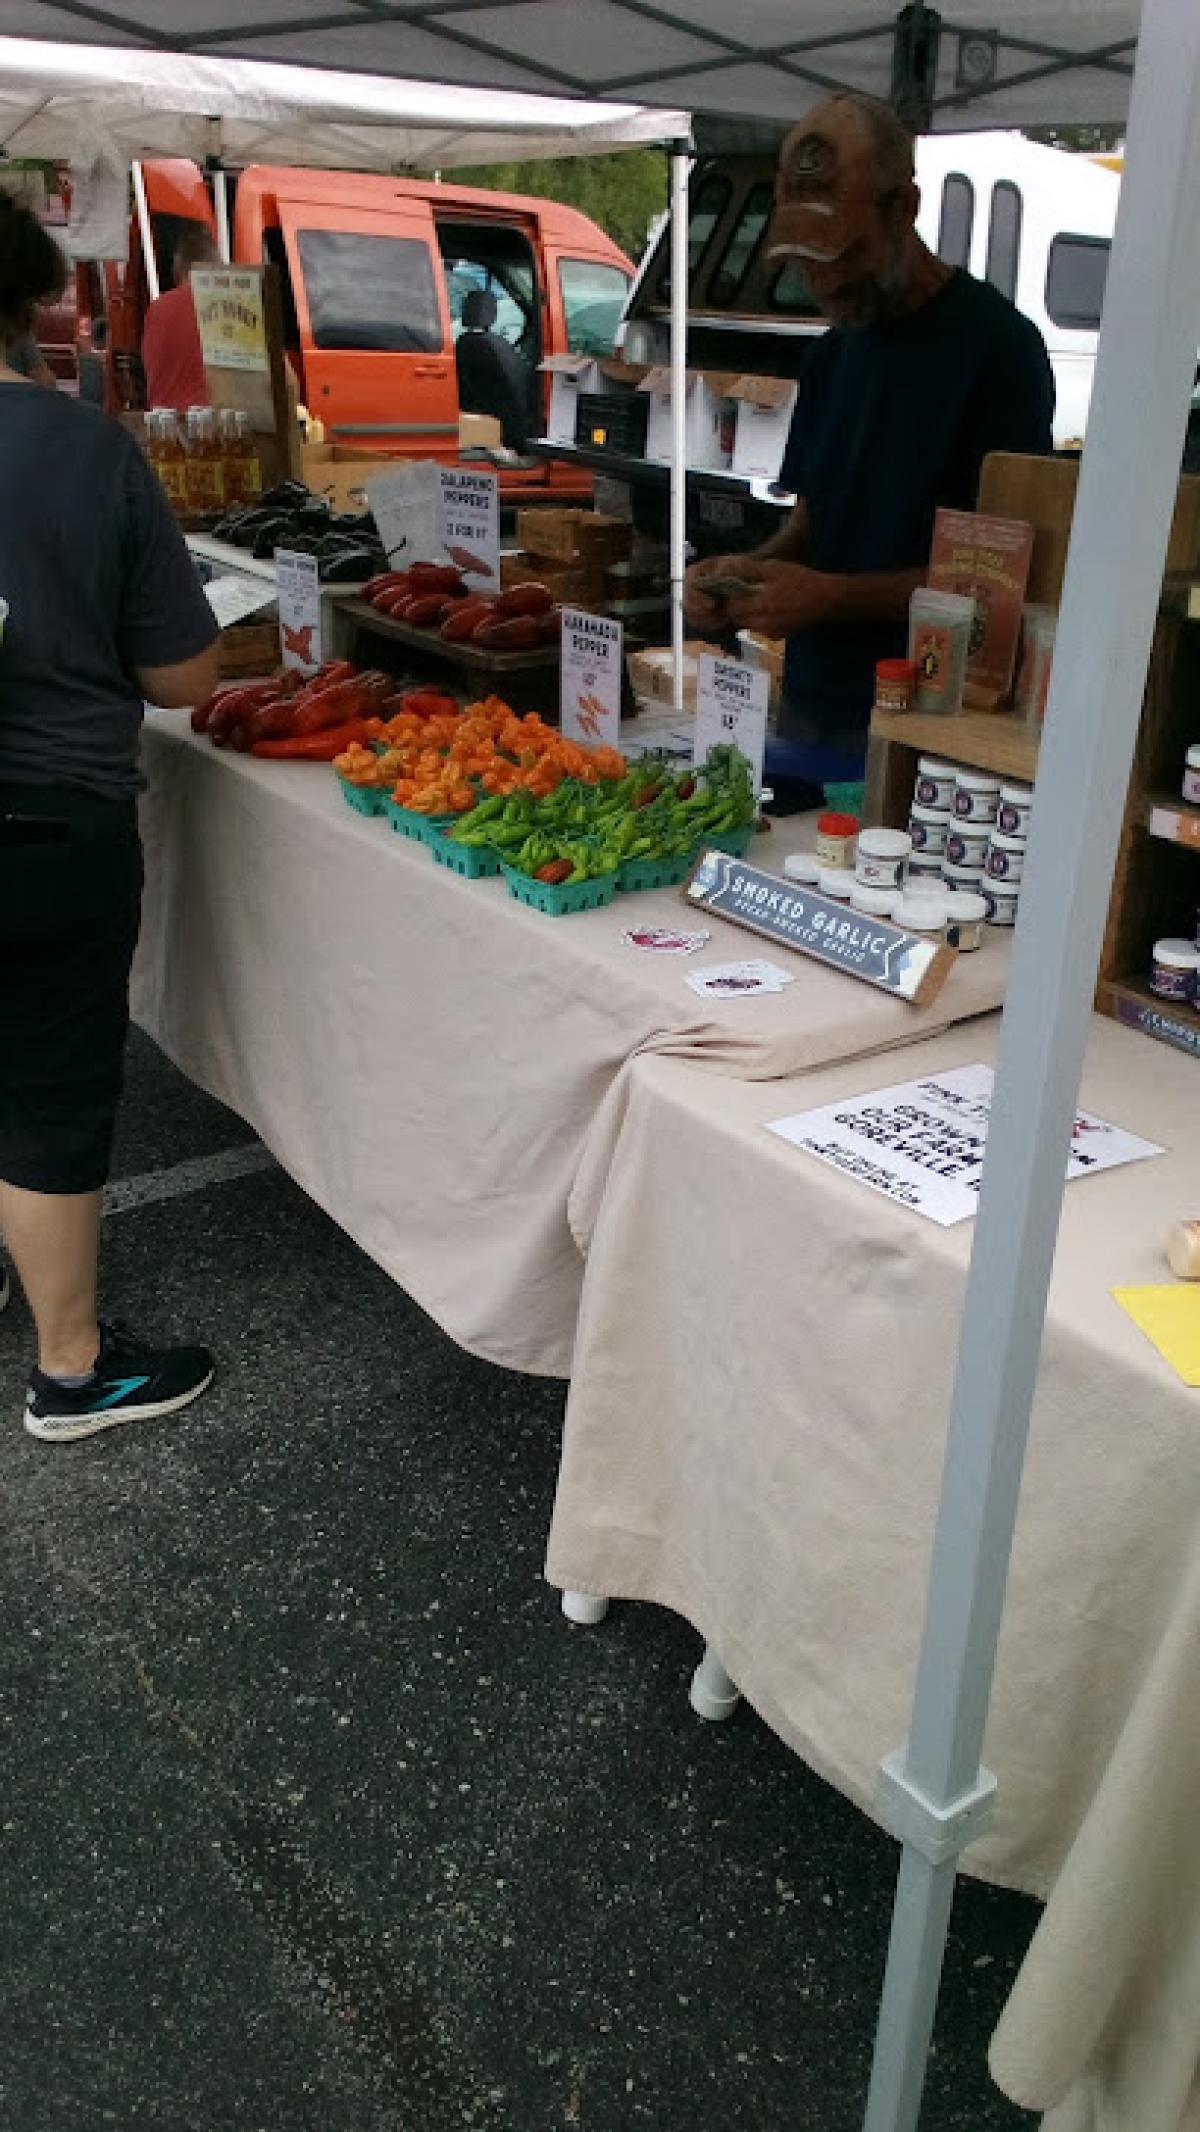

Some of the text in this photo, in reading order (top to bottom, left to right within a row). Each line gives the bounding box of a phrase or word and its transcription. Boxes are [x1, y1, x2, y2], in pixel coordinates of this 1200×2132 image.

[443, 490, 489, 510] PEPPERS
[731, 876, 886, 954] SMOKED GARLIC
[861, 1107, 913, 1133] OUR
[908, 1131, 983, 1165] FARM
[893, 1105, 985, 1147] GROWN
